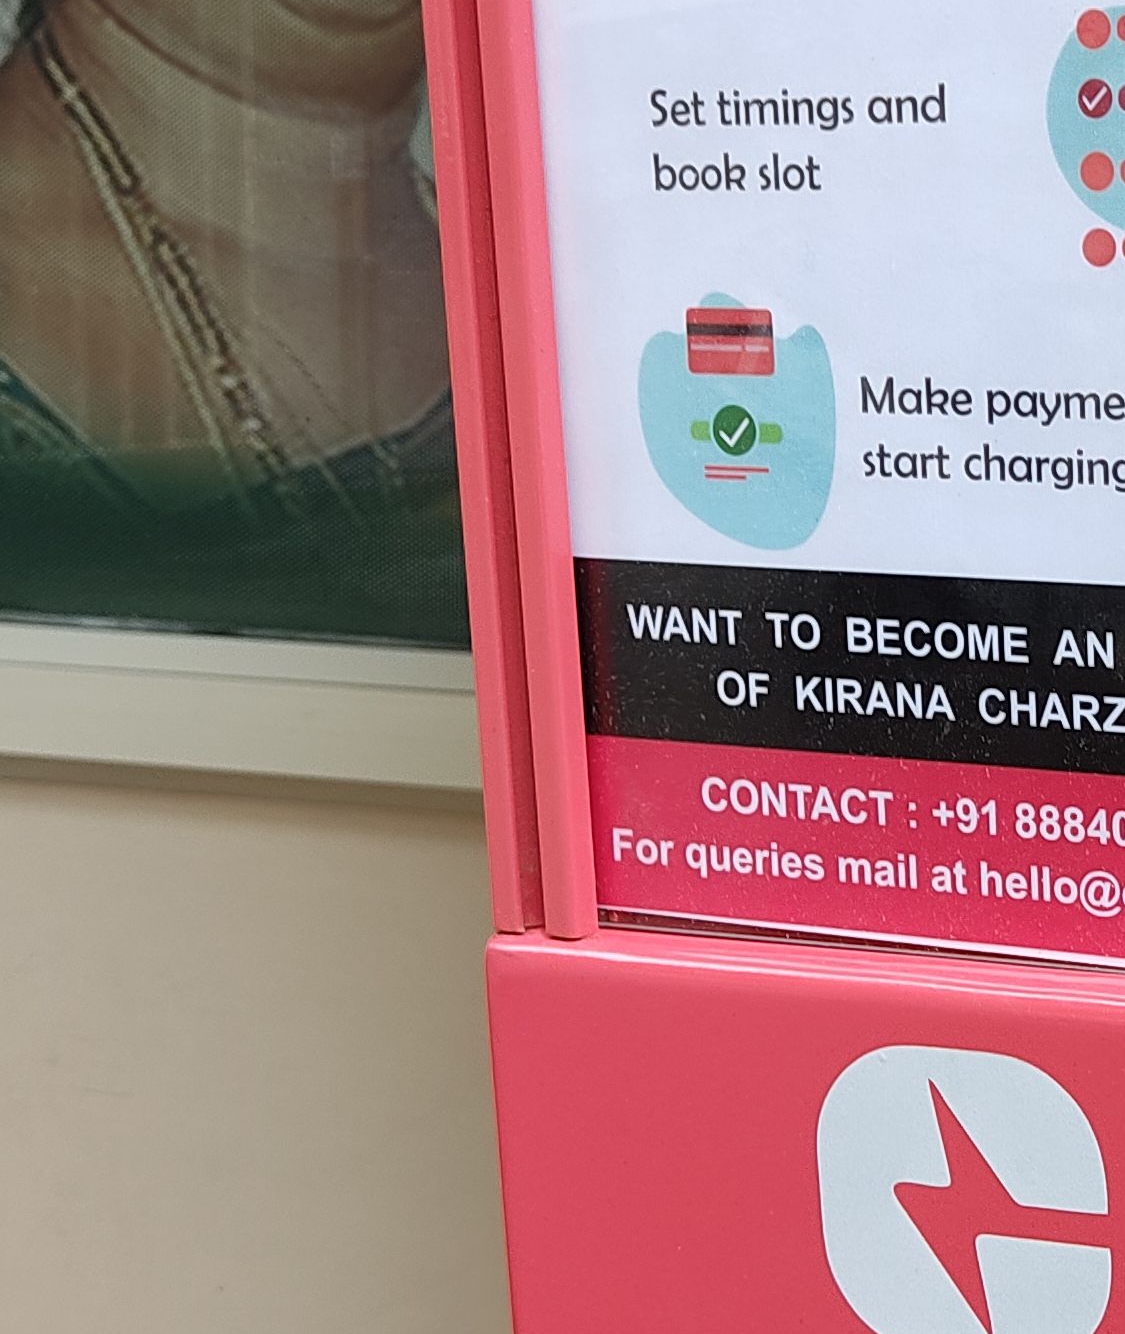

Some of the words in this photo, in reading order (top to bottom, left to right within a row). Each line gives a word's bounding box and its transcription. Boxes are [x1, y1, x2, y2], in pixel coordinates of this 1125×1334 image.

[650, 89, 705, 128] Set
[717, 86, 854, 131] timings
[868, 83, 946, 124] and
[653, 153, 746, 191] book
[760, 153, 822, 191] slot
[860, 376, 973, 416] Make
[863, 445, 950, 480] start
[626, 604, 742, 646] WANT
[766, 612, 820, 650] TO
[846, 619, 1030, 665] BECOME
[1053, 629, 1115, 669] AN
[716, 671, 770, 707] OF
[796, 678, 956, 723] KIRANA
[701, 776, 893, 826] CONTACT
[908, 800, 918, 828] :
[931, 799, 998, 836] +91
[612, 828, 675, 867] For
[685, 837, 825, 882] queries
[837, 854, 919, 892] mail
[932, 864, 969, 897] at
